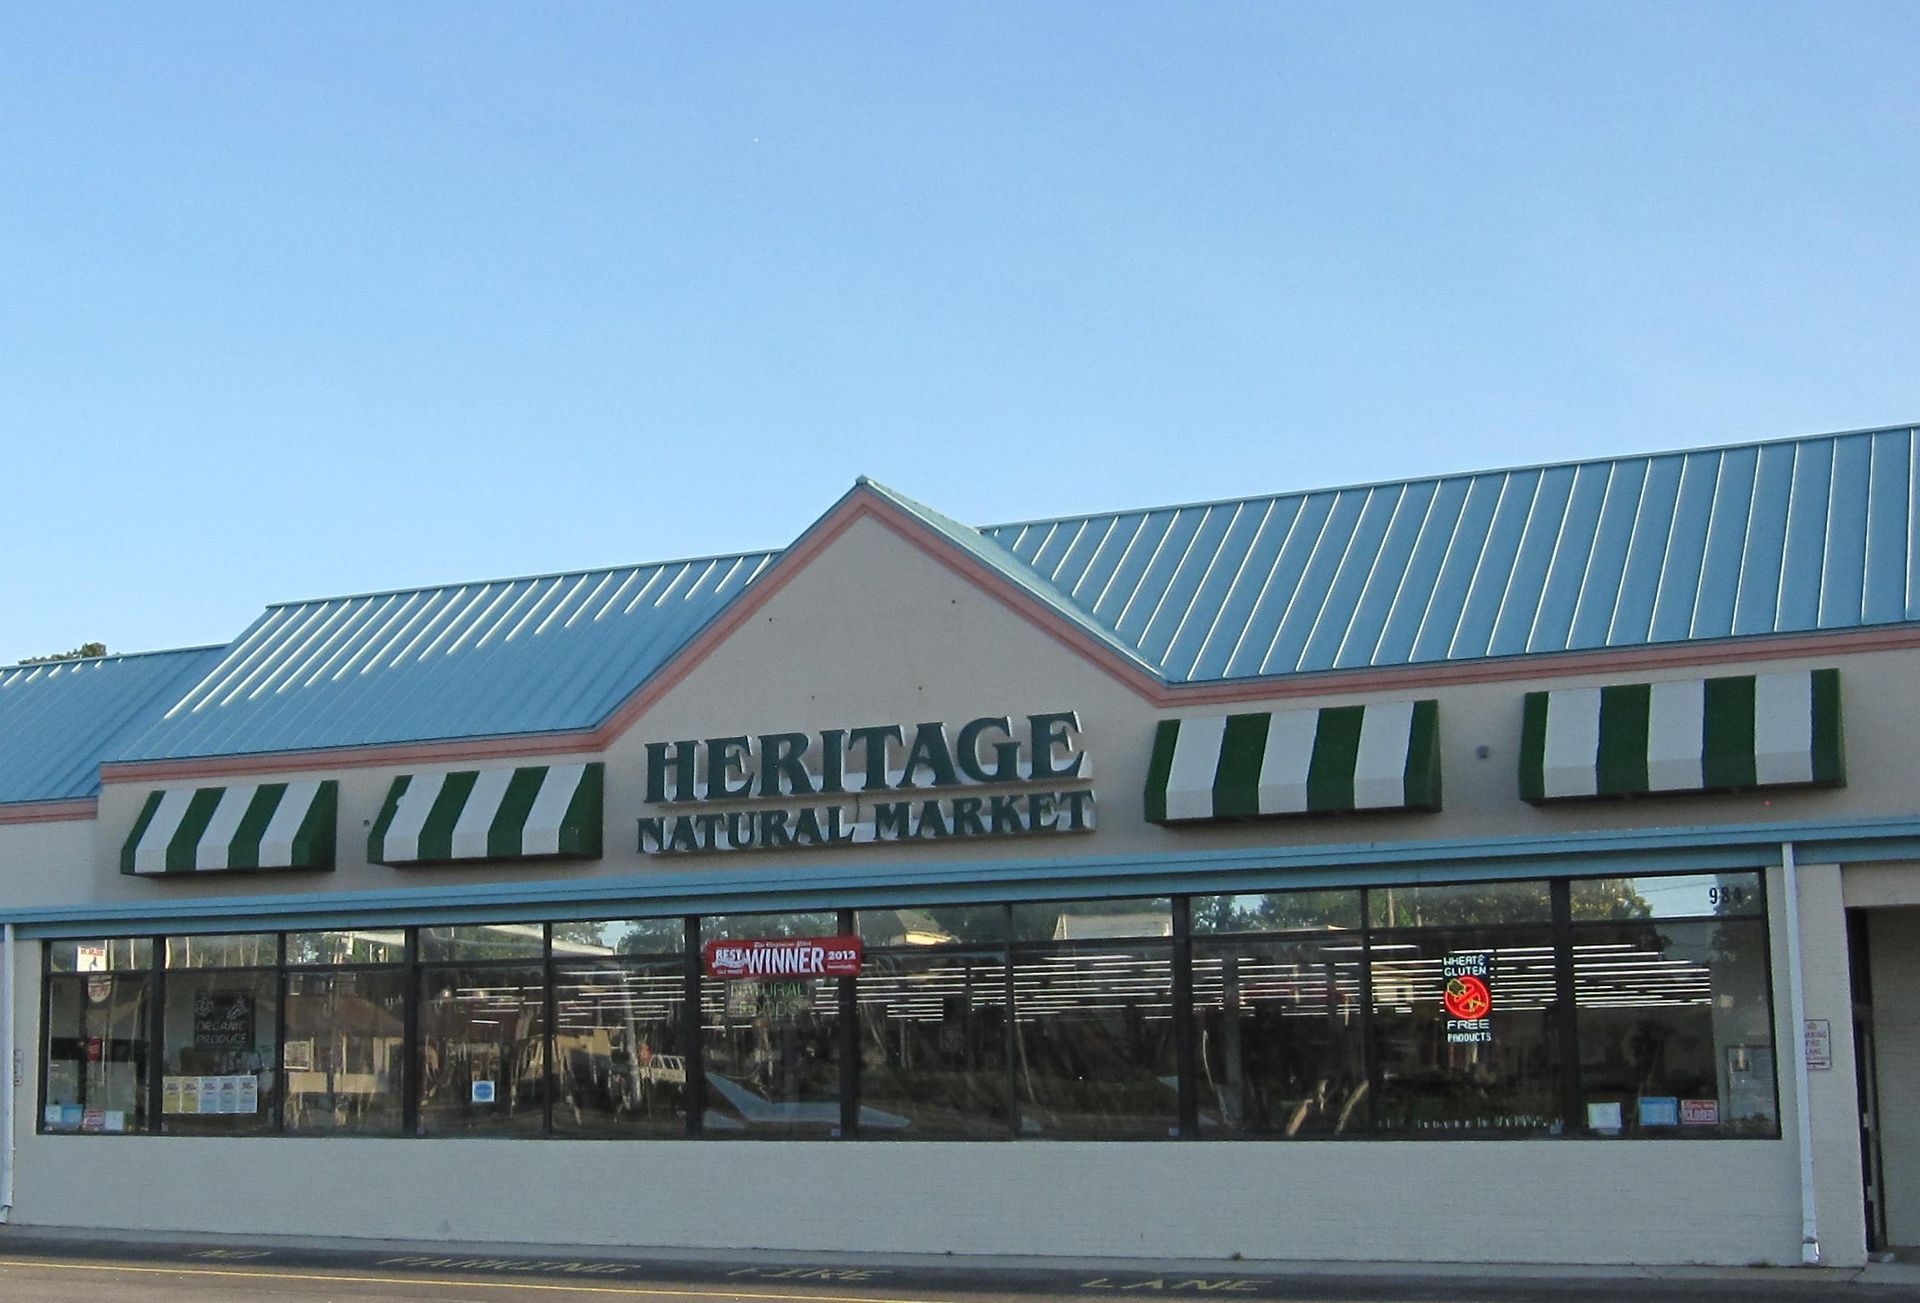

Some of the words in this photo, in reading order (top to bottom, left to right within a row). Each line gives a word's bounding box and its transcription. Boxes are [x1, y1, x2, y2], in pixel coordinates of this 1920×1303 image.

[644, 711, 1084, 803] HERITAGE
[636, 805, 857, 854] NATURAL
[873, 790, 1096, 841] MARKET
[745, 946, 825, 974] WINNER
[828, 950, 857, 961] 2012
[1443, 955, 1478, 966] WHEAT
[1444, 966, 1487, 976] GLUTEN
[1447, 1019, 1490, 1030] FREE
[1447, 1032, 1492, 1043] PRODUCTS
[1080, 1277, 1274, 1291] LANE
